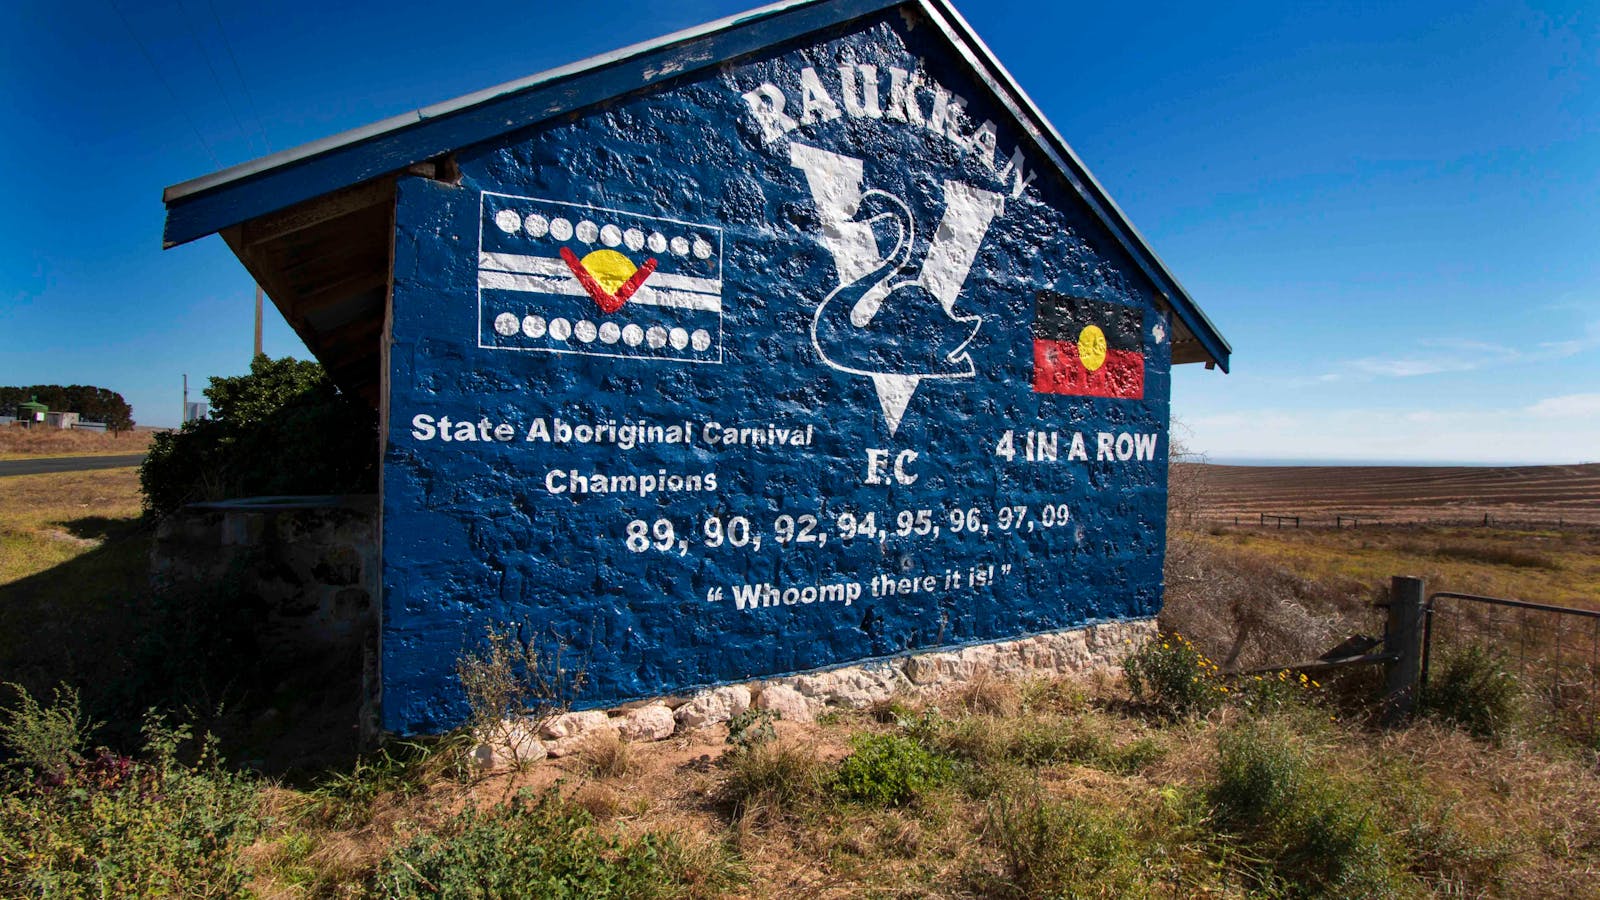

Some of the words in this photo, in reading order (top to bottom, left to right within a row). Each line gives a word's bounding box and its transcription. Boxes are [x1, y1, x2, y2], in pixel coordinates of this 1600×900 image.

[741, 63, 1038, 200] RAUKKAN
[411, 414, 515, 442] State
[526, 417, 693, 450] Aboriginal
[703, 421, 814, 446] Carnival
[995, 430, 1016, 462] 4
[1026, 431, 1058, 462] IN
[1068, 432, 1088, 462] A
[1097, 432, 1157, 462] ROW
[545, 469, 718, 497] Champions
[1042, 503, 1070, 528] 09
[732, 581, 861, 611] Whoomp
[871, 573, 937, 597] there
[944, 569, 961, 590] it
[968, 565, 994, 588] is!
